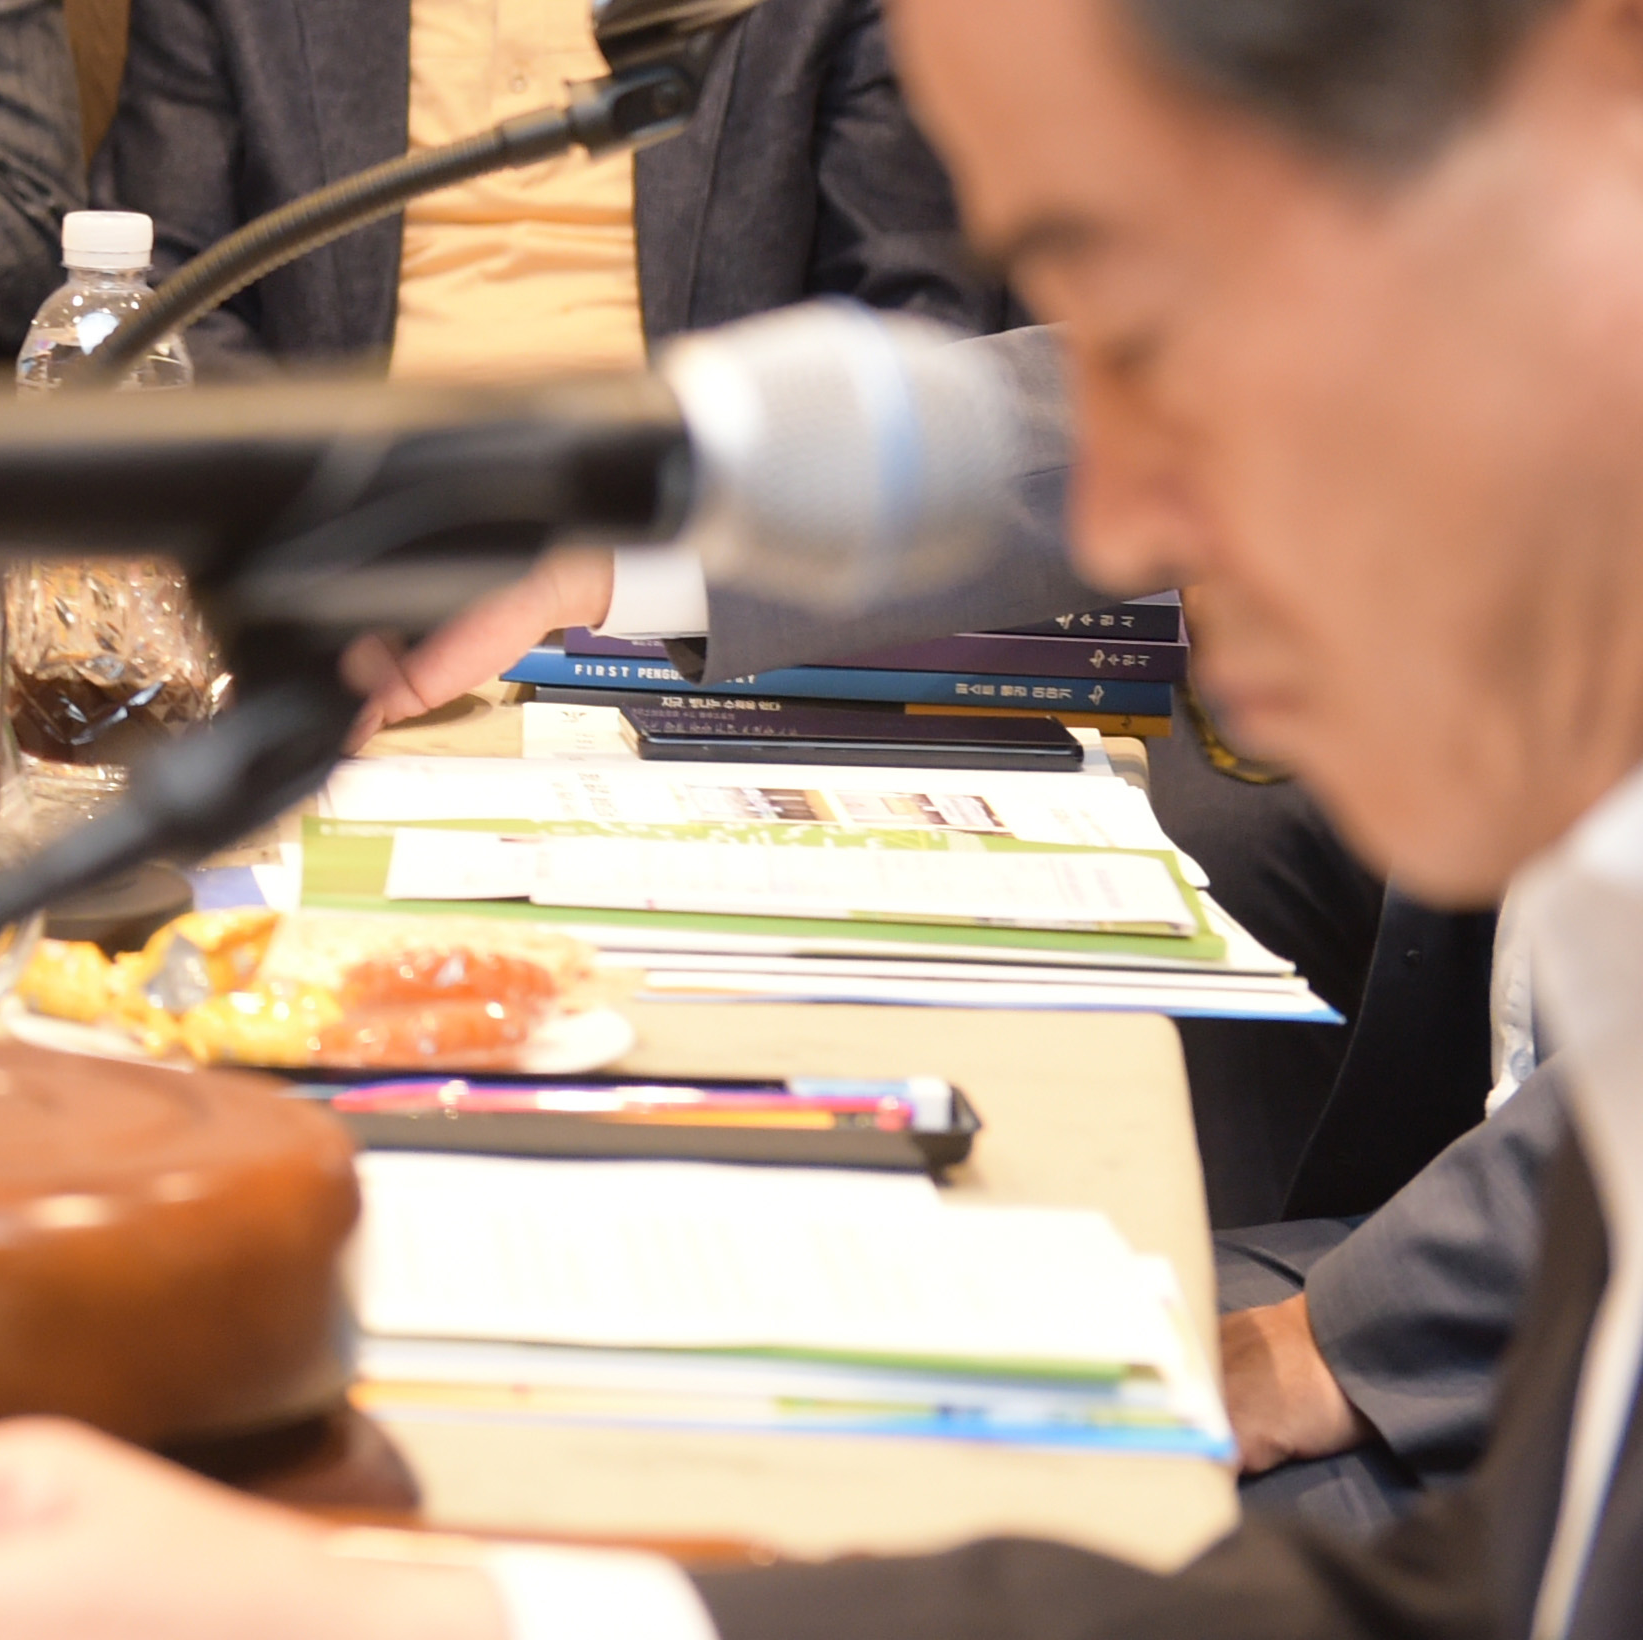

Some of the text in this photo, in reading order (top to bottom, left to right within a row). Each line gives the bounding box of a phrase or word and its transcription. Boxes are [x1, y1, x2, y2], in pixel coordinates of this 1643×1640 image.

[1079, 613, 1135, 629] 수원시
[574, 664, 684, 681] FIRST PENGU
